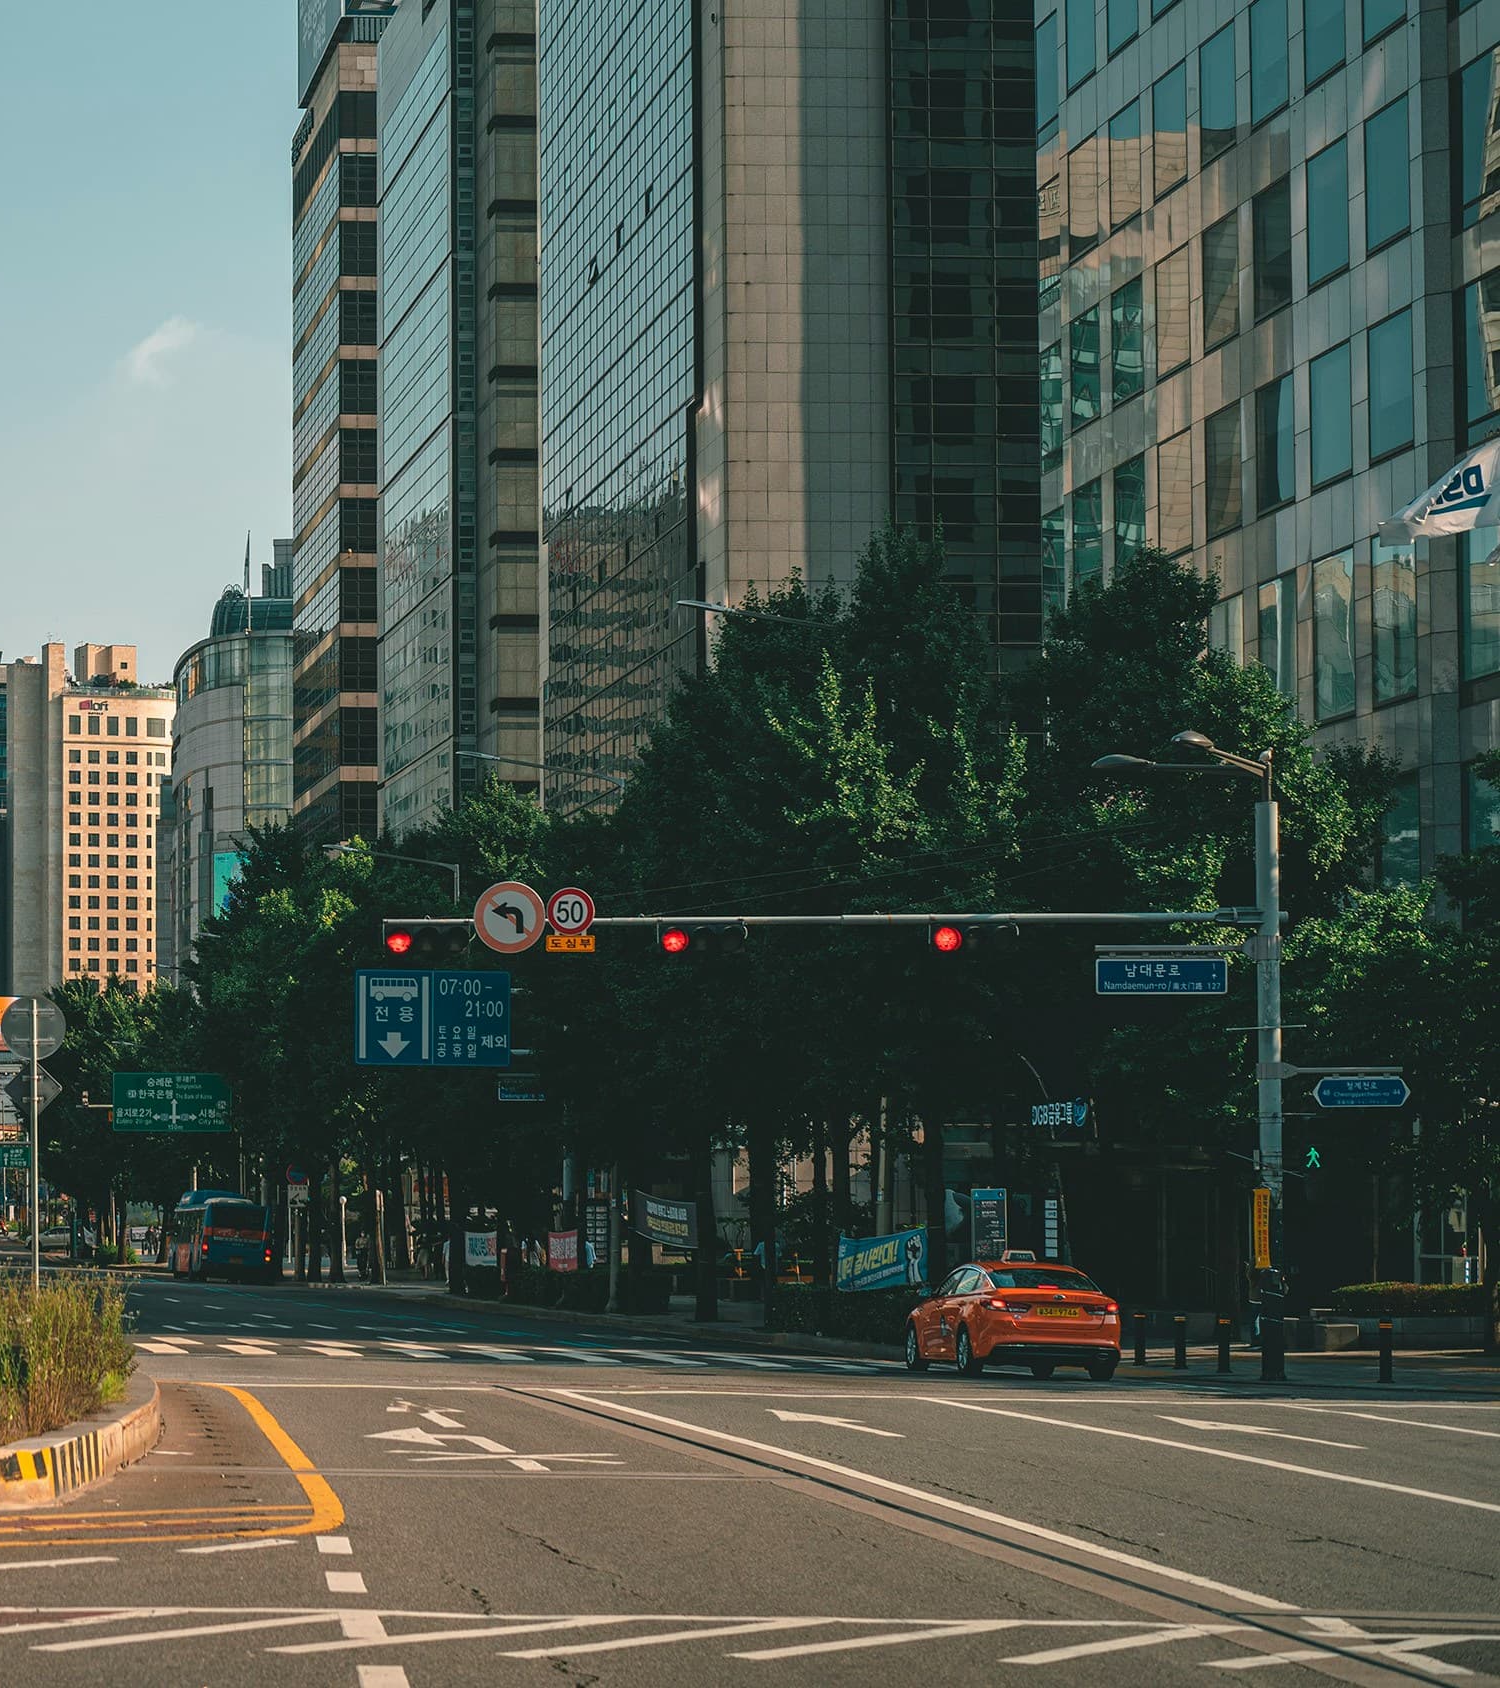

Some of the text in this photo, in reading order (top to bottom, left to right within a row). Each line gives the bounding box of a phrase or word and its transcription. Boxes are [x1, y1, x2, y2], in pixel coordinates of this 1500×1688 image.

[557, 901, 583, 923] 50
[550, 938, 591, 949] 도심부
[1125, 963, 1181, 977] 남대문로
[1206, 982, 1221, 990] 127
[465, 1001, 504, 1017] 21:00
[481, 1035, 508, 1048] 제외
[147, 1077, 173, 1087] 숭례문
[1346, 1081, 1379, 1090] 청계천로
[138, 1089, 173, 1099] 한국은행
[116, 1108, 153, 1118] 을지로2가
[198, 1109, 216, 1119] 시청
